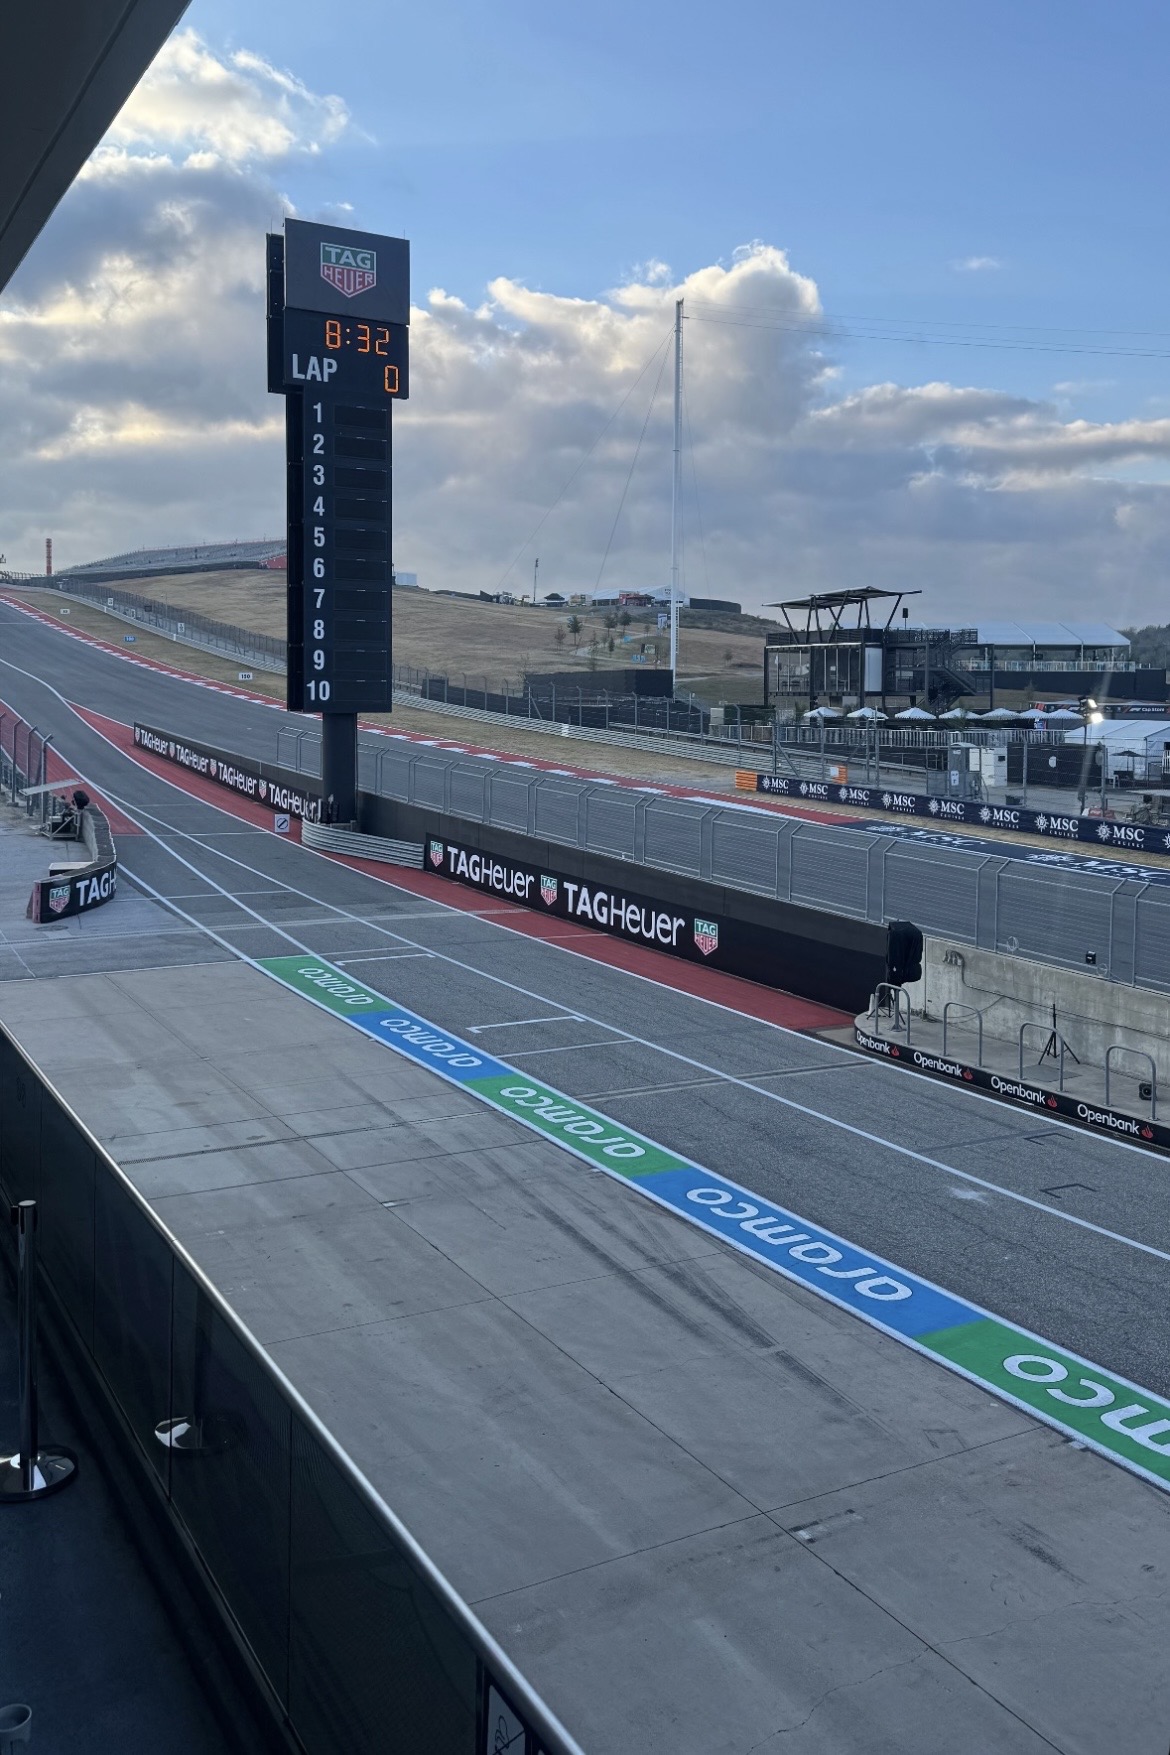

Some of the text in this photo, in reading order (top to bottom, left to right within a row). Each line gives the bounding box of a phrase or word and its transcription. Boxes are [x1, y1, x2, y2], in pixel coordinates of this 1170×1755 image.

[325, 246, 371, 269] TAG
[324, 266, 373, 294] HEUER
[325, 320, 390, 355] 8:32
[292, 353, 338, 383] LAP
[384, 365, 399, 393] 0
[313, 402, 322, 423] 1
[313, 433, 325, 454] 2
[313, 464, 325, 485] 3
[313, 496, 325, 516] 4
[313, 527, 325, 547] 5
[313, 558, 325, 578] 6
[313, 588, 325, 609] 7
[313, 619, 325, 640] 8
[313, 649, 325, 670] 9
[306, 680, 331, 701] 10
[771, 778, 789, 789] MSC
[809, 783, 828, 795] MSC
[849, 788, 870, 801] MSC
[893, 794, 915, 808] MSC
[941, 801, 965, 815] MSC
[993, 808, 1020, 823] MSC
[1050, 816, 1079, 832] MSC
[1113, 825, 1145, 842] MSC
[52, 888, 69, 898] TAG
[543, 877, 557, 889] TAG
[696, 921, 717, 936] TAG
[695, 934, 717, 952] HEUER
[297, 967, 374, 1005] aramco
[380, 1018, 483, 1067] aramco
[856, 1030, 890, 1055] Openbank
[914, 1051, 962, 1078] Openbank
[990, 1075, 1046, 1105] Openbank
[500, 1086, 646, 1158] aramco
[1077, 1103, 1140, 1135] Openbank
[686, 1187, 913, 1301] aramco
